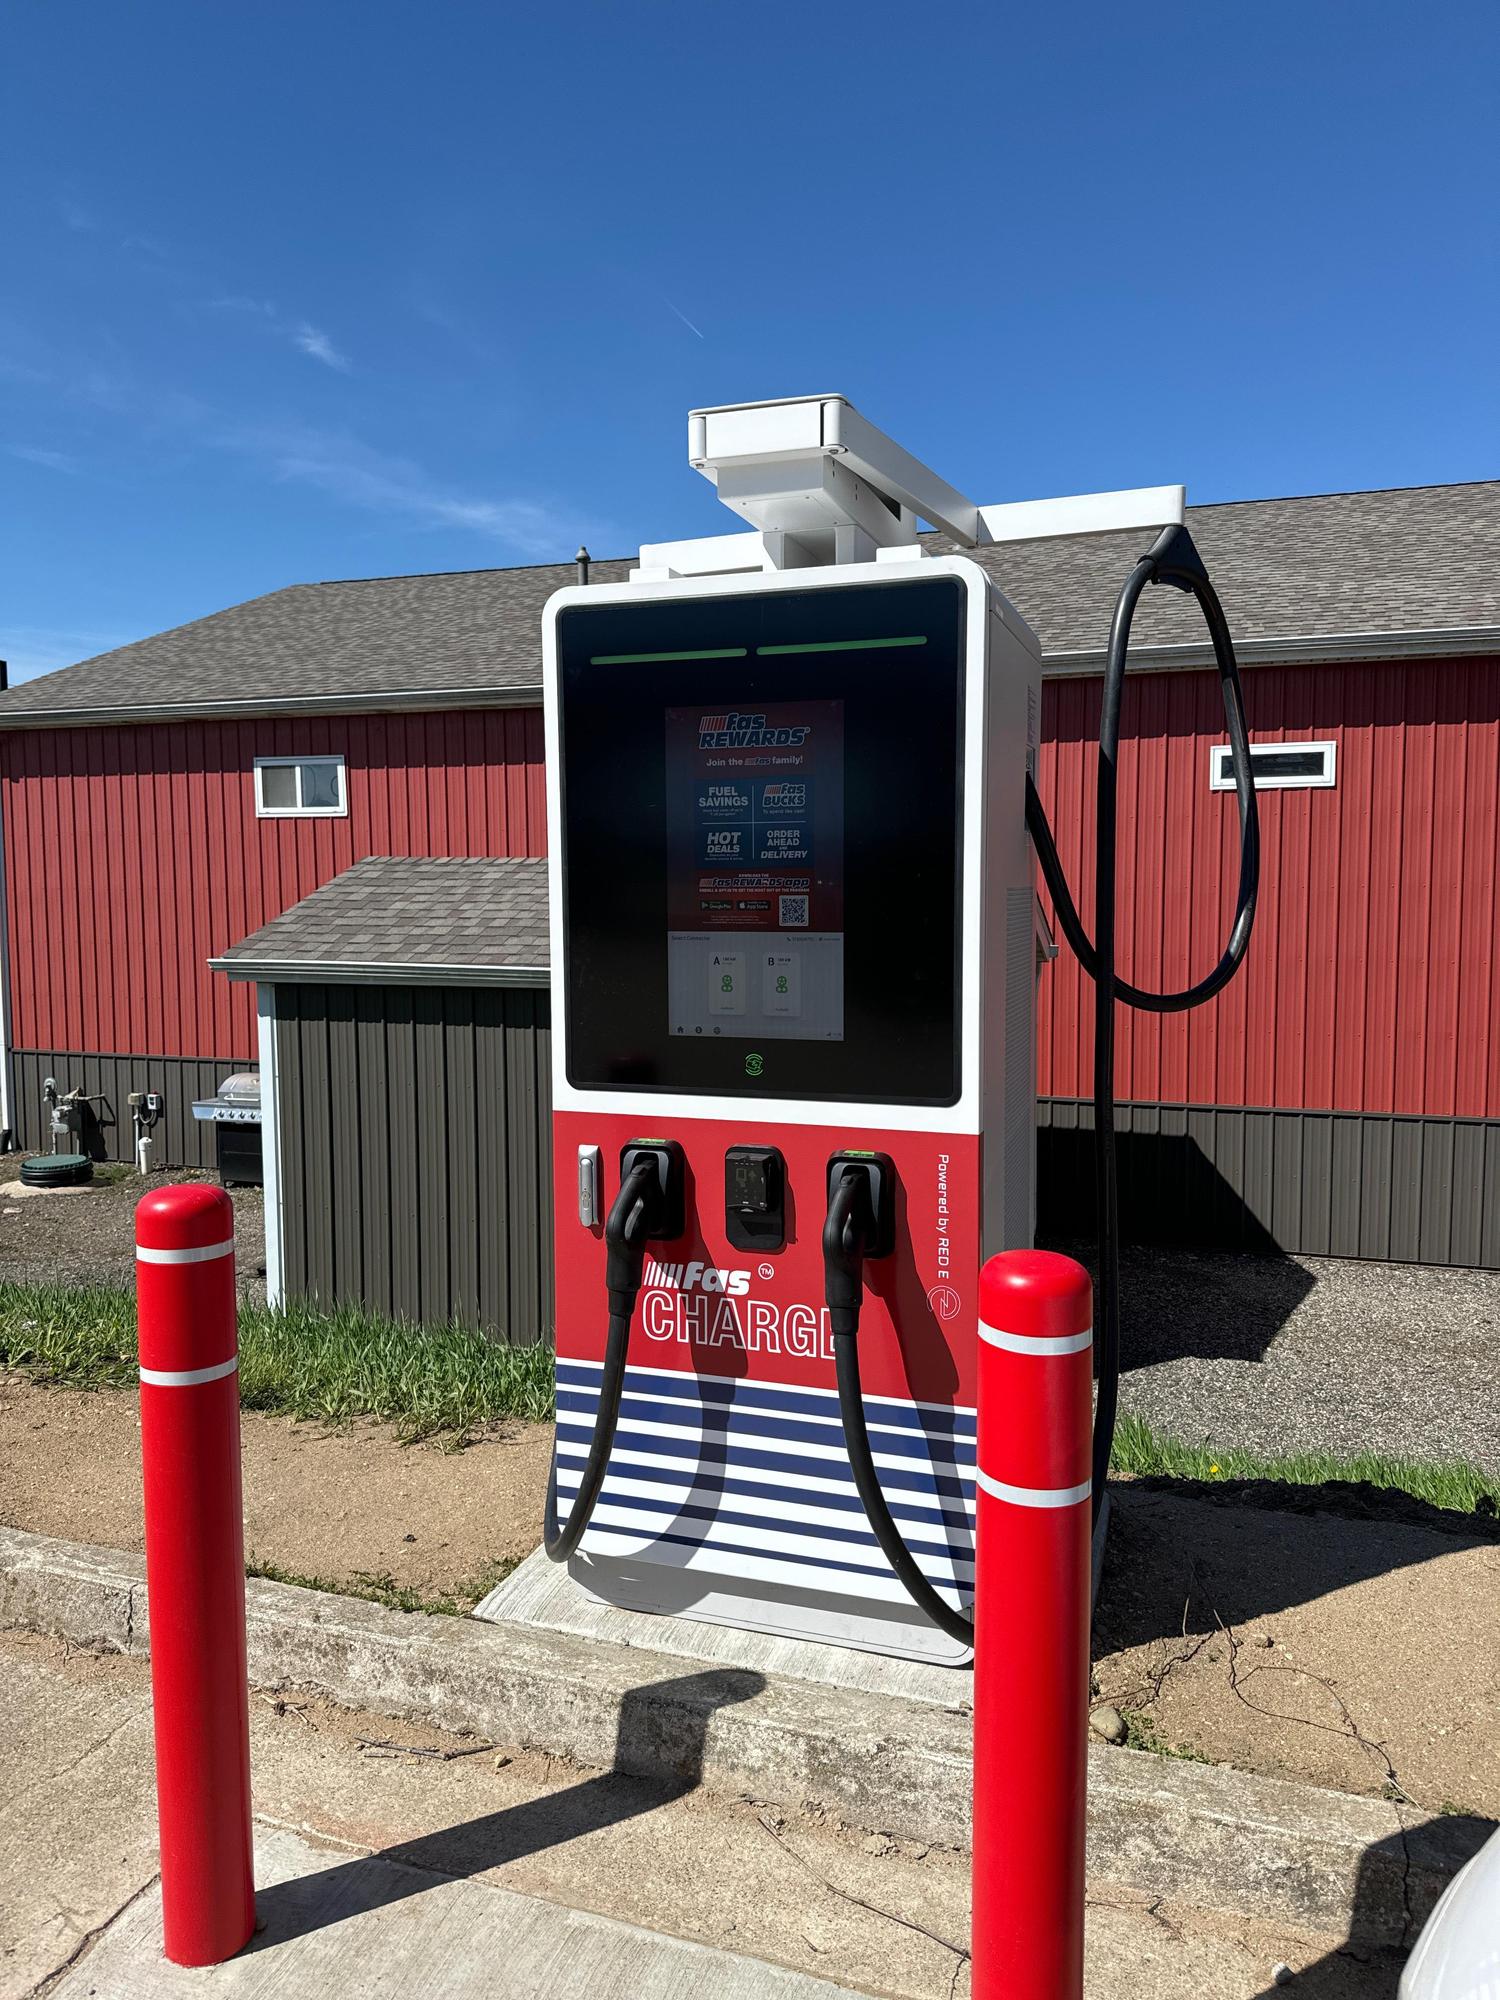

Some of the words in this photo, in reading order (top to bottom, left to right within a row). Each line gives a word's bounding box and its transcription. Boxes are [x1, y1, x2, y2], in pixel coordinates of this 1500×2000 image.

[706, 758, 726, 767] Join
[728, 758, 743, 766] the
[772, 755, 803, 766] family!
[708, 786, 738, 796] FUEL
[698, 796, 749, 807] SAVINGS
[762, 795, 806, 807] BUCKS
[707, 832, 742, 845] HOT
[766, 830, 800, 838] ORDER
[767, 838, 800, 846] AHEAD
[707, 845, 740, 853] DEALS
[761, 850, 808, 859] DELIVERY
[784, 878, 809, 887] app
[713, 956, 721, 965] A
[768, 957, 775, 966] B
[938, 1154, 949, 1214] Powered
[936, 1217, 950, 1234] by
[938, 1237, 950, 1266] RED
[682, 1261, 751, 1296] fas
[938, 1270, 949, 1279] E
